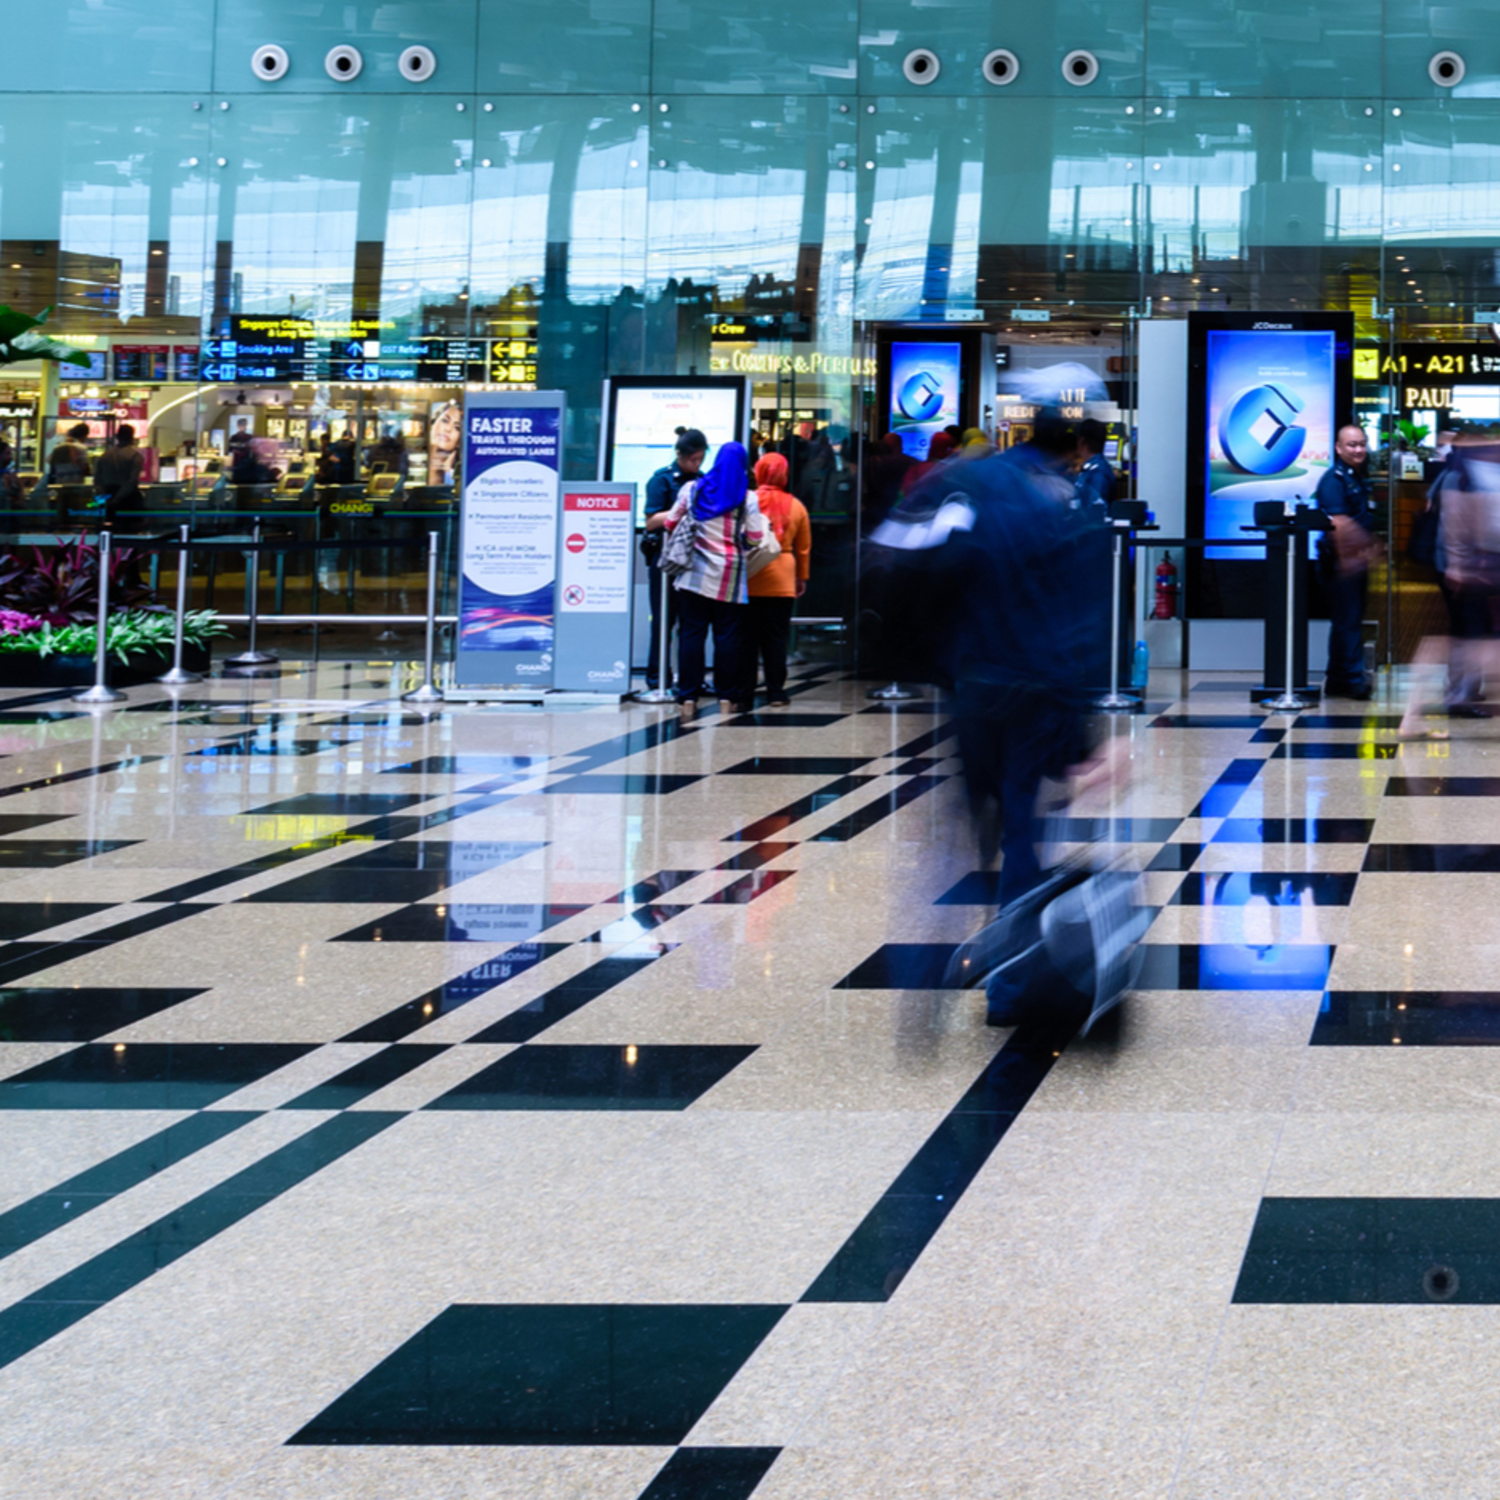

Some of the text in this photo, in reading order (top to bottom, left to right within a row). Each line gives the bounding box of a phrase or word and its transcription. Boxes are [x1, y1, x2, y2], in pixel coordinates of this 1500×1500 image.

[1381, 355, 1408, 373] A1
[1426, 355, 1464, 373] A21
[1405, 387, 1453, 408] PAUL
[471, 417, 532, 433] FASTER
[471, 435, 556, 445] TRAVEL THROUGH
[475, 447, 556, 456] AUTOMATED LANES
[576, 497, 620, 508] NOTICE
